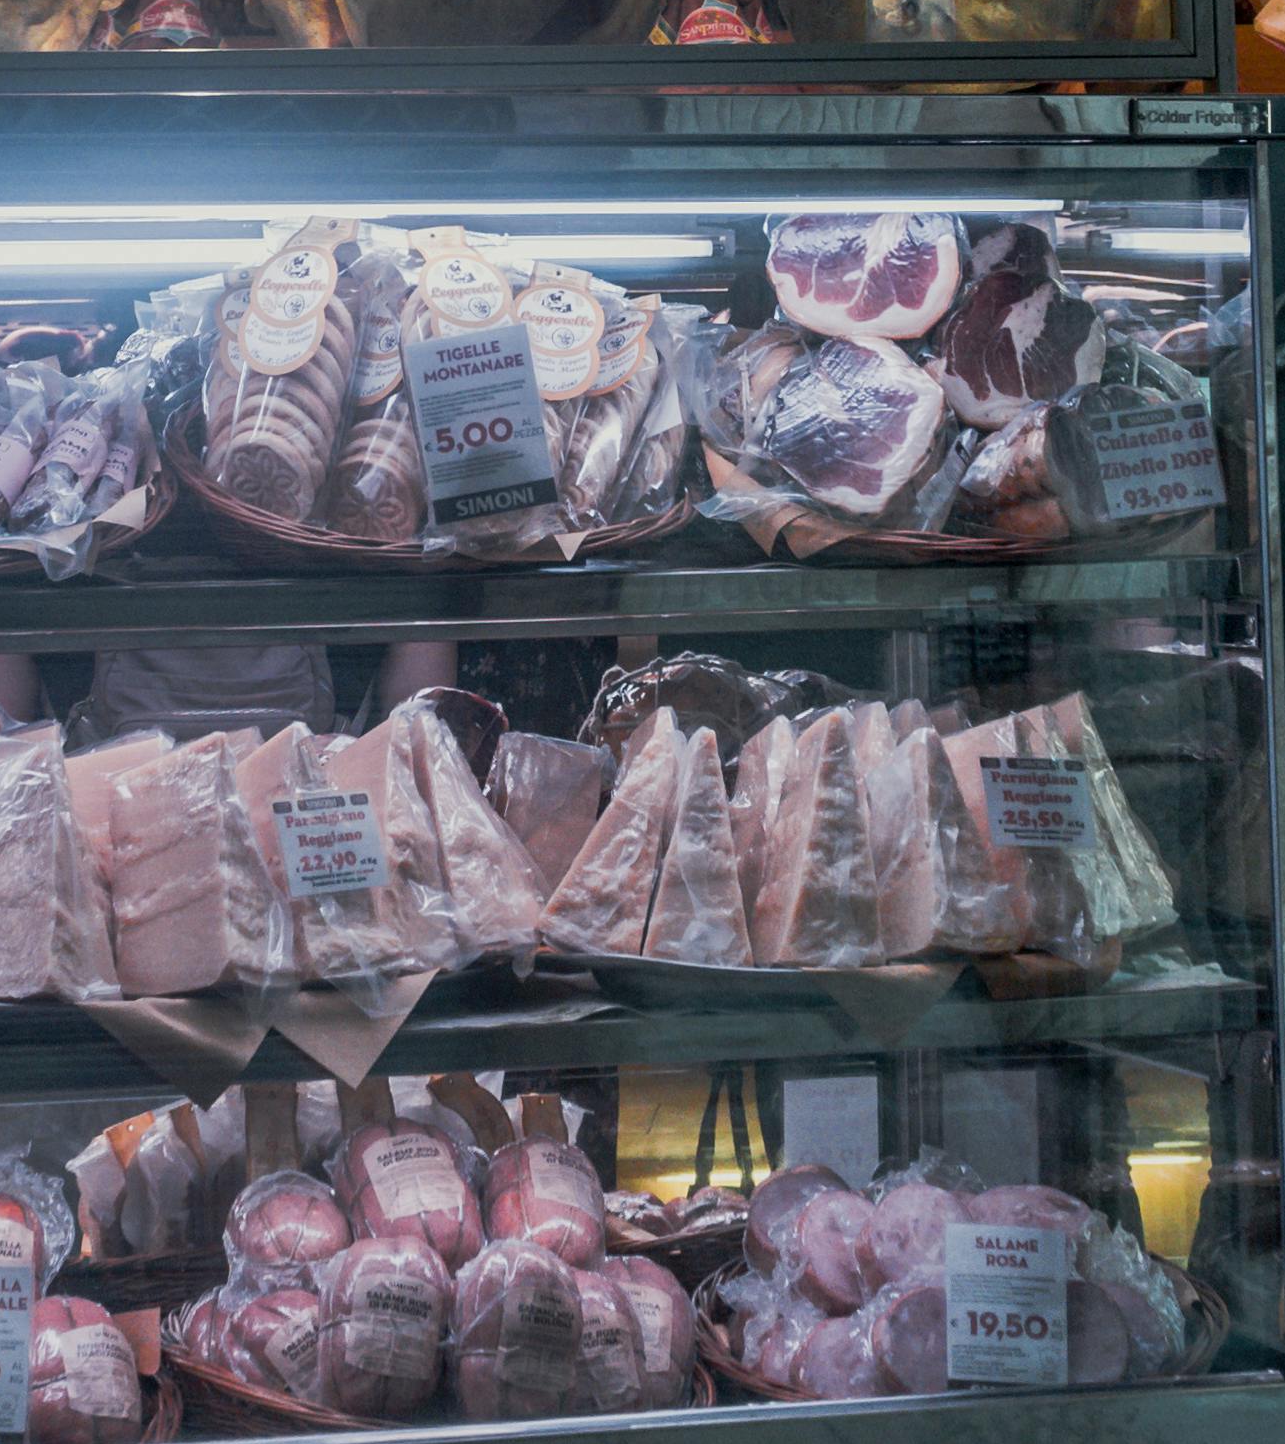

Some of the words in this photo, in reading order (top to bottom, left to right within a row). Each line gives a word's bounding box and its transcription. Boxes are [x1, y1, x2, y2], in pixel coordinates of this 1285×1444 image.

[436, 340, 501, 363] TIGELLE
[423, 354, 525, 384] MONTANARE
[435, 417, 513, 454] 5,00
[1097, 426, 1184, 452] Culatello
[1188, 421, 1208, 439] di
[1100, 457, 1167, 480] Zibello
[1171, 447, 1215, 470] DOP
[454, 486, 534, 517] SIMONI
[1123, 482, 1188, 510] 93,90
[990, 771, 1078, 787] Parmigiano
[1002, 790, 1073, 806] Reggiano
[284, 811, 366, 829] Parmigiano
[1002, 810, 1064, 829] 25,50
[297, 831, 363, 848] Reggiano
[299, 850, 357, 873] 22,90
[975, 1235, 1040, 1254] SALAME
[986, 1254, 1029, 1269] ROSA
[967, 1310, 1049, 1342] 19,50
